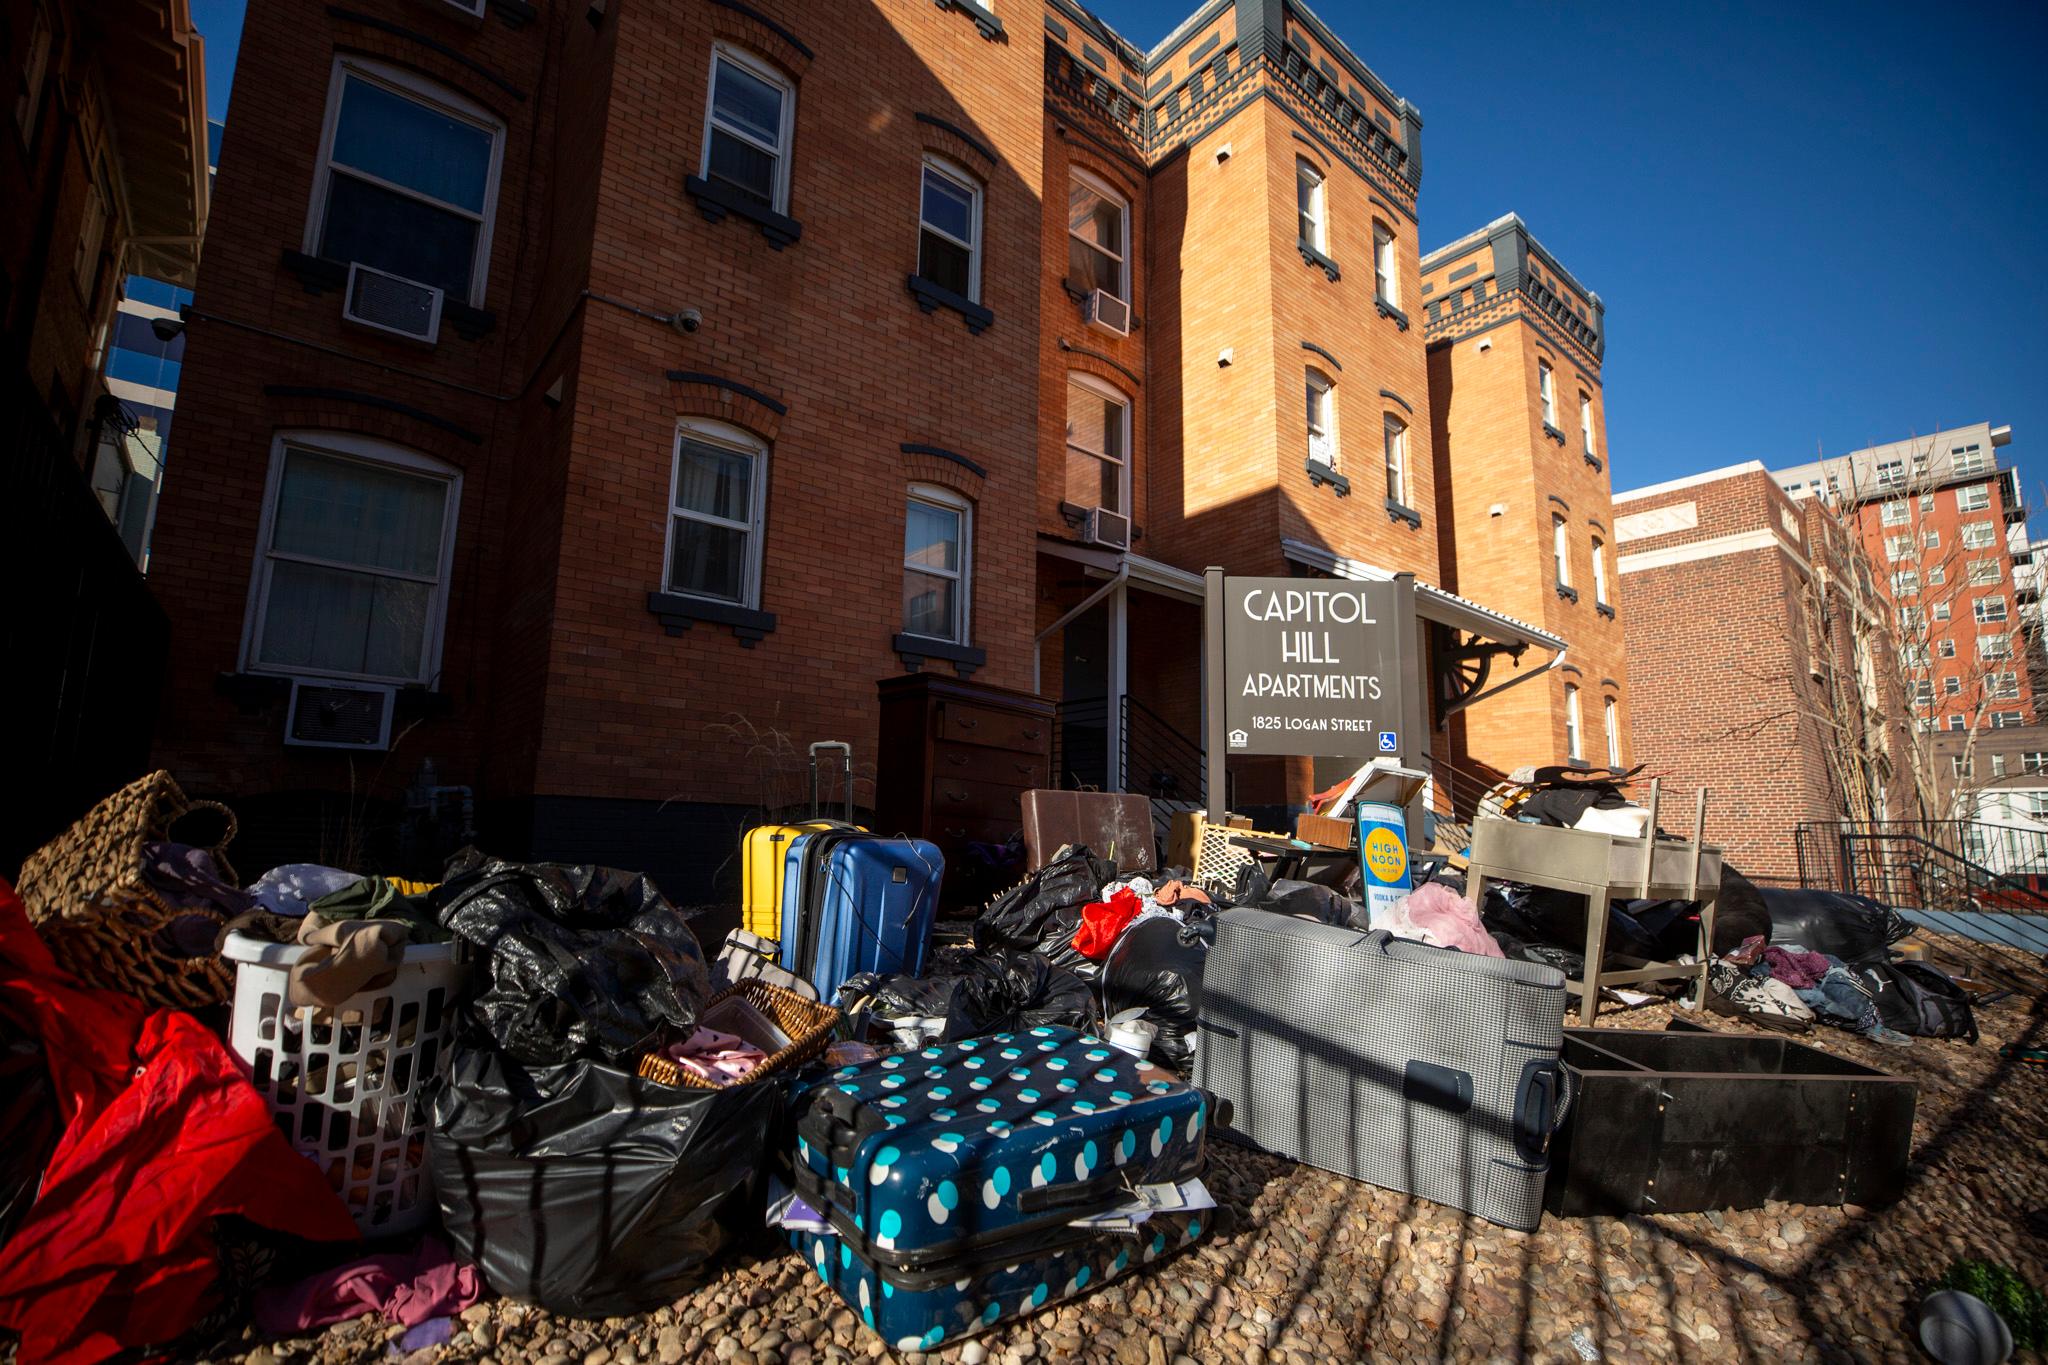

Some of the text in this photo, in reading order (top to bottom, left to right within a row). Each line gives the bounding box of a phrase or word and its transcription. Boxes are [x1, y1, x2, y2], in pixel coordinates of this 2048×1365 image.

[1243, 589, 1377, 624] CAPITOL
[1281, 631, 1340, 664] HILL
[1242, 673, 1382, 700] APARTMENTS
[1252, 716, 1373, 732] 1825 LOGAN STREET
[1372, 842, 1399, 855] HIGH
[1371, 853, 1401, 867] NOON
